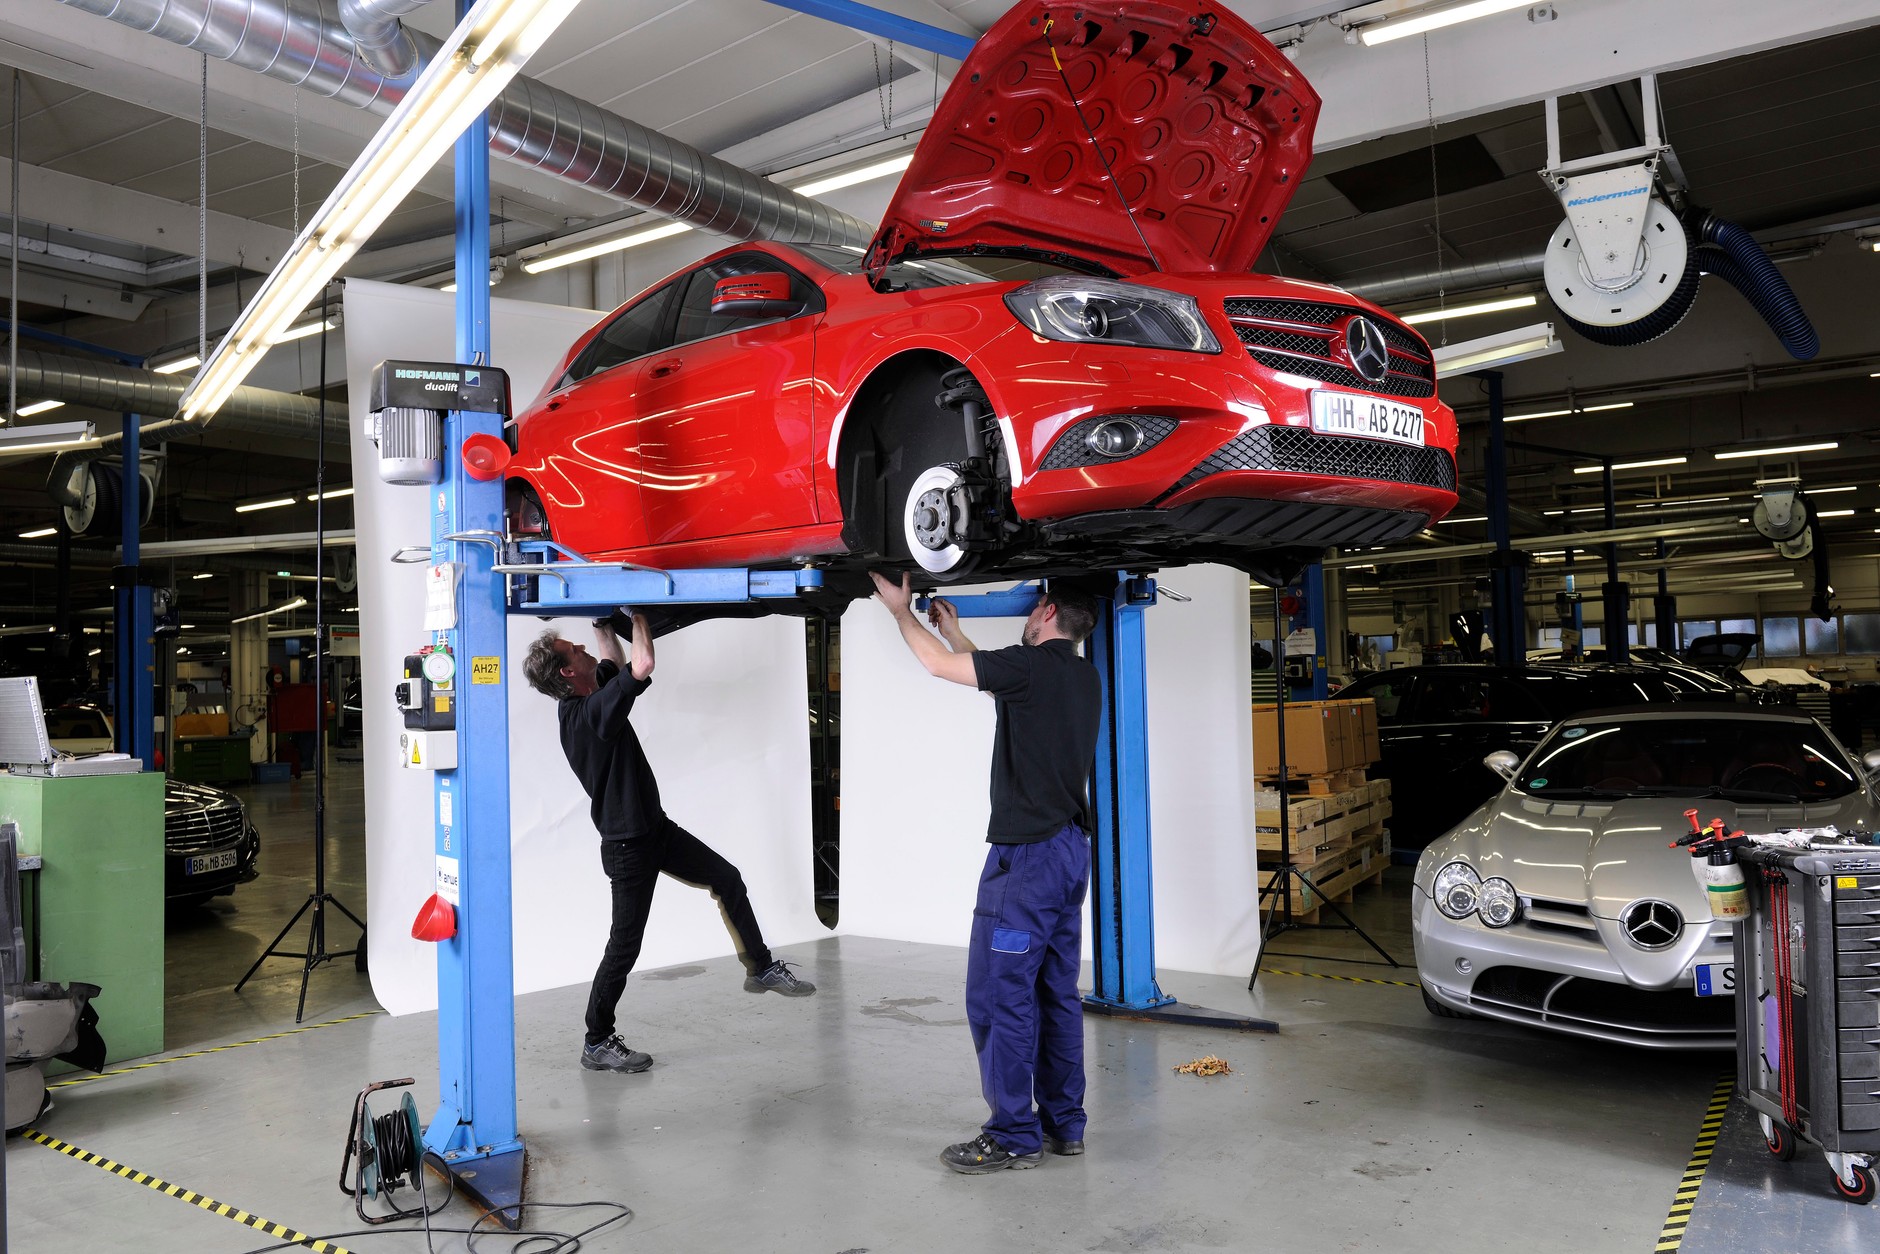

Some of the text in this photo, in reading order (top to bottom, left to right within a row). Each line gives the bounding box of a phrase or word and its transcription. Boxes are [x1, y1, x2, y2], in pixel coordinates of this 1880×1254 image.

[1567, 186, 1649, 207] Nederman
[395, 369, 460, 381] HOFMANN
[424, 382, 459, 393] duolift
[1329, 397, 1422, 441] HH AB 2277
[473, 663, 499, 674] AH27
[193, 852, 236, 872] BB MB 3596
[1722, 967, 1735, 990] S
[1701, 983, 1707, 991] D
